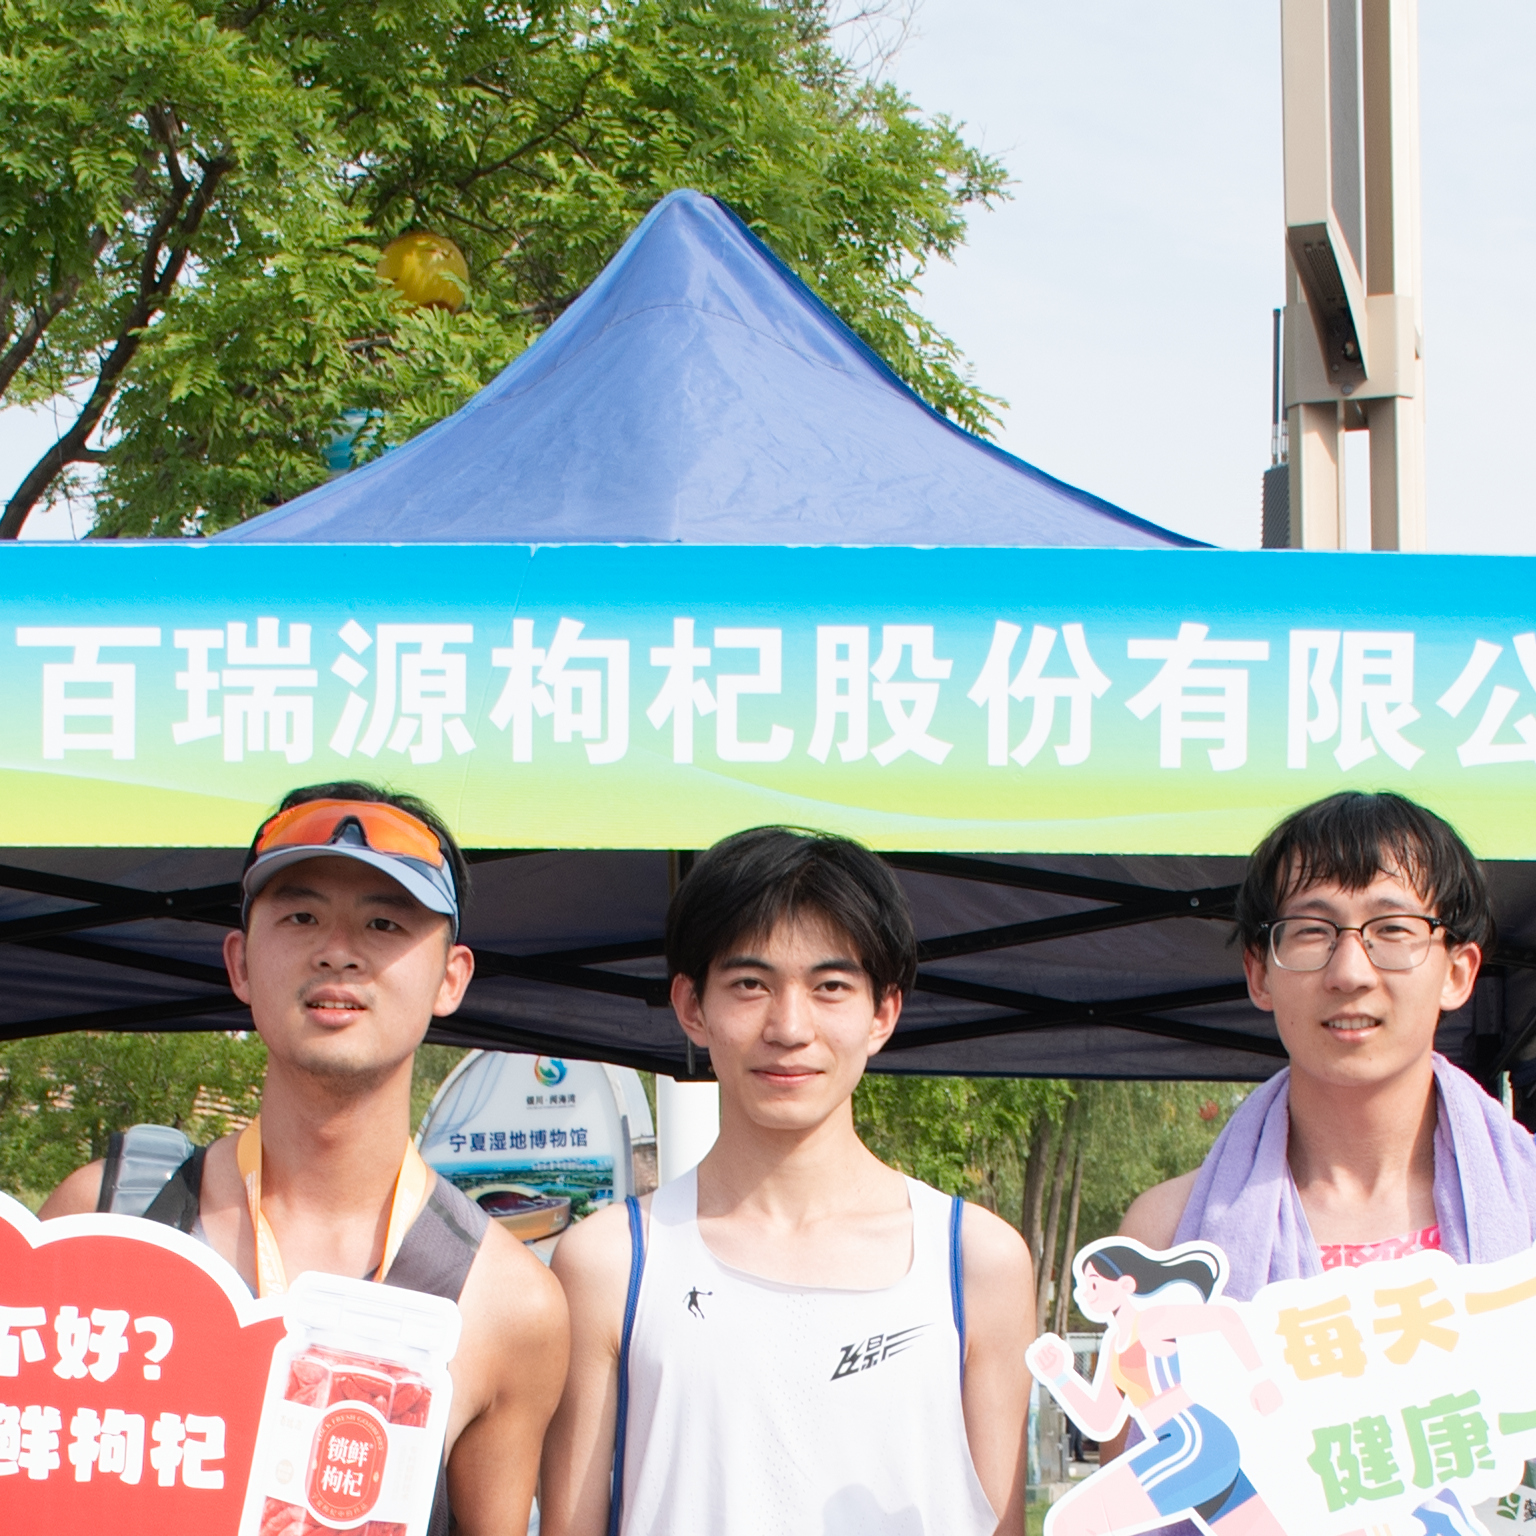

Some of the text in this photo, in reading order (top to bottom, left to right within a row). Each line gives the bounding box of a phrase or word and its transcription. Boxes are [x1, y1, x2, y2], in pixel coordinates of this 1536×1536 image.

[449, 1127, 589, 1153] 宁夏湿地博物馆
[327, 1435, 369, 1468] 锁鲜
[321, 1465, 364, 1497] 枸杞
